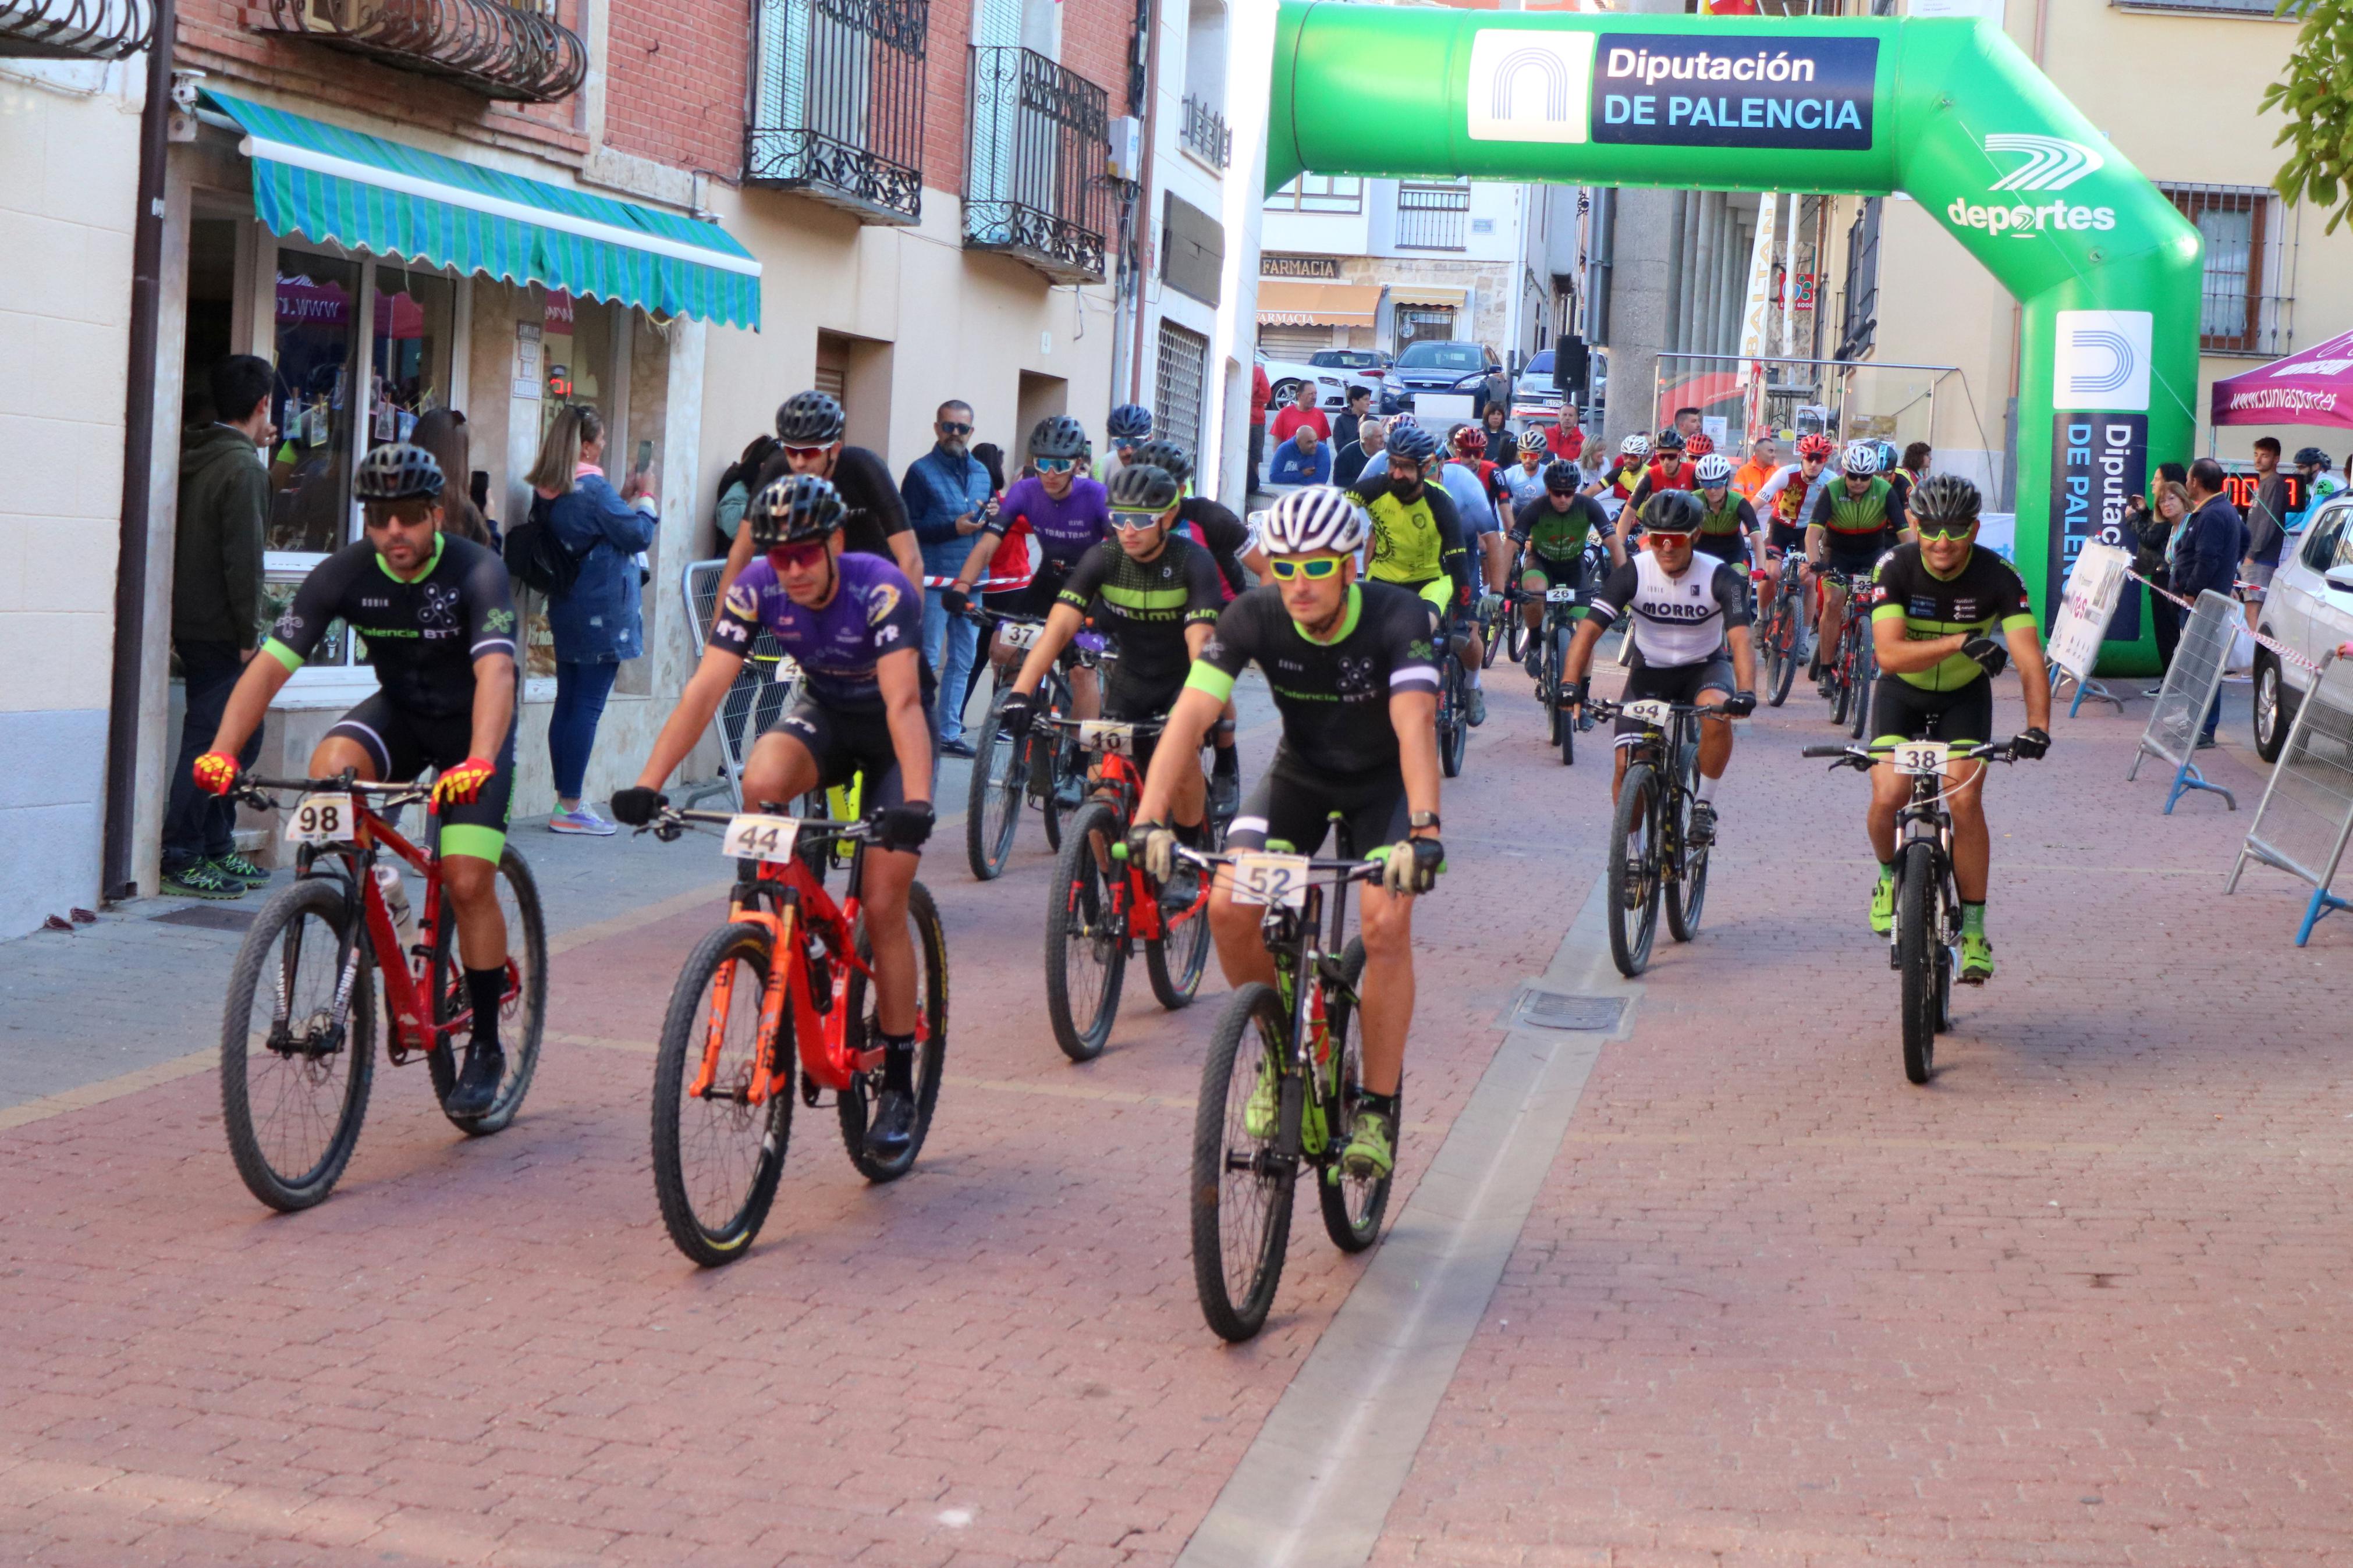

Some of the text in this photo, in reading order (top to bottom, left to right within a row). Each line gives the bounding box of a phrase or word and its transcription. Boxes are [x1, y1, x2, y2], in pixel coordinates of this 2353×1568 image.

[1606, 48, 1815, 86] Diputación
[1604, 95, 1862, 130] DE PALENCIA
[1947, 197, 2116, 237] deportes
[1262, 259, 1335, 277] FARMACIA
[2230, 387, 2337, 416] www.runvasport.es
[2067, 424, 2092, 466] DE
[2099, 424, 2131, 552] Diputac
[2061, 476, 2090, 596] PALEN
[1552, 590, 1569, 598] 26
[1642, 602, 1709, 618] MORRO
[1009, 626, 1034, 643] 37
[1091, 731, 1122, 749] 10
[1905, 750, 1937, 769] 38
[299, 806, 339, 833] 98
[737, 825, 779, 853] 44
[1249, 867, 1291, 895] 52
